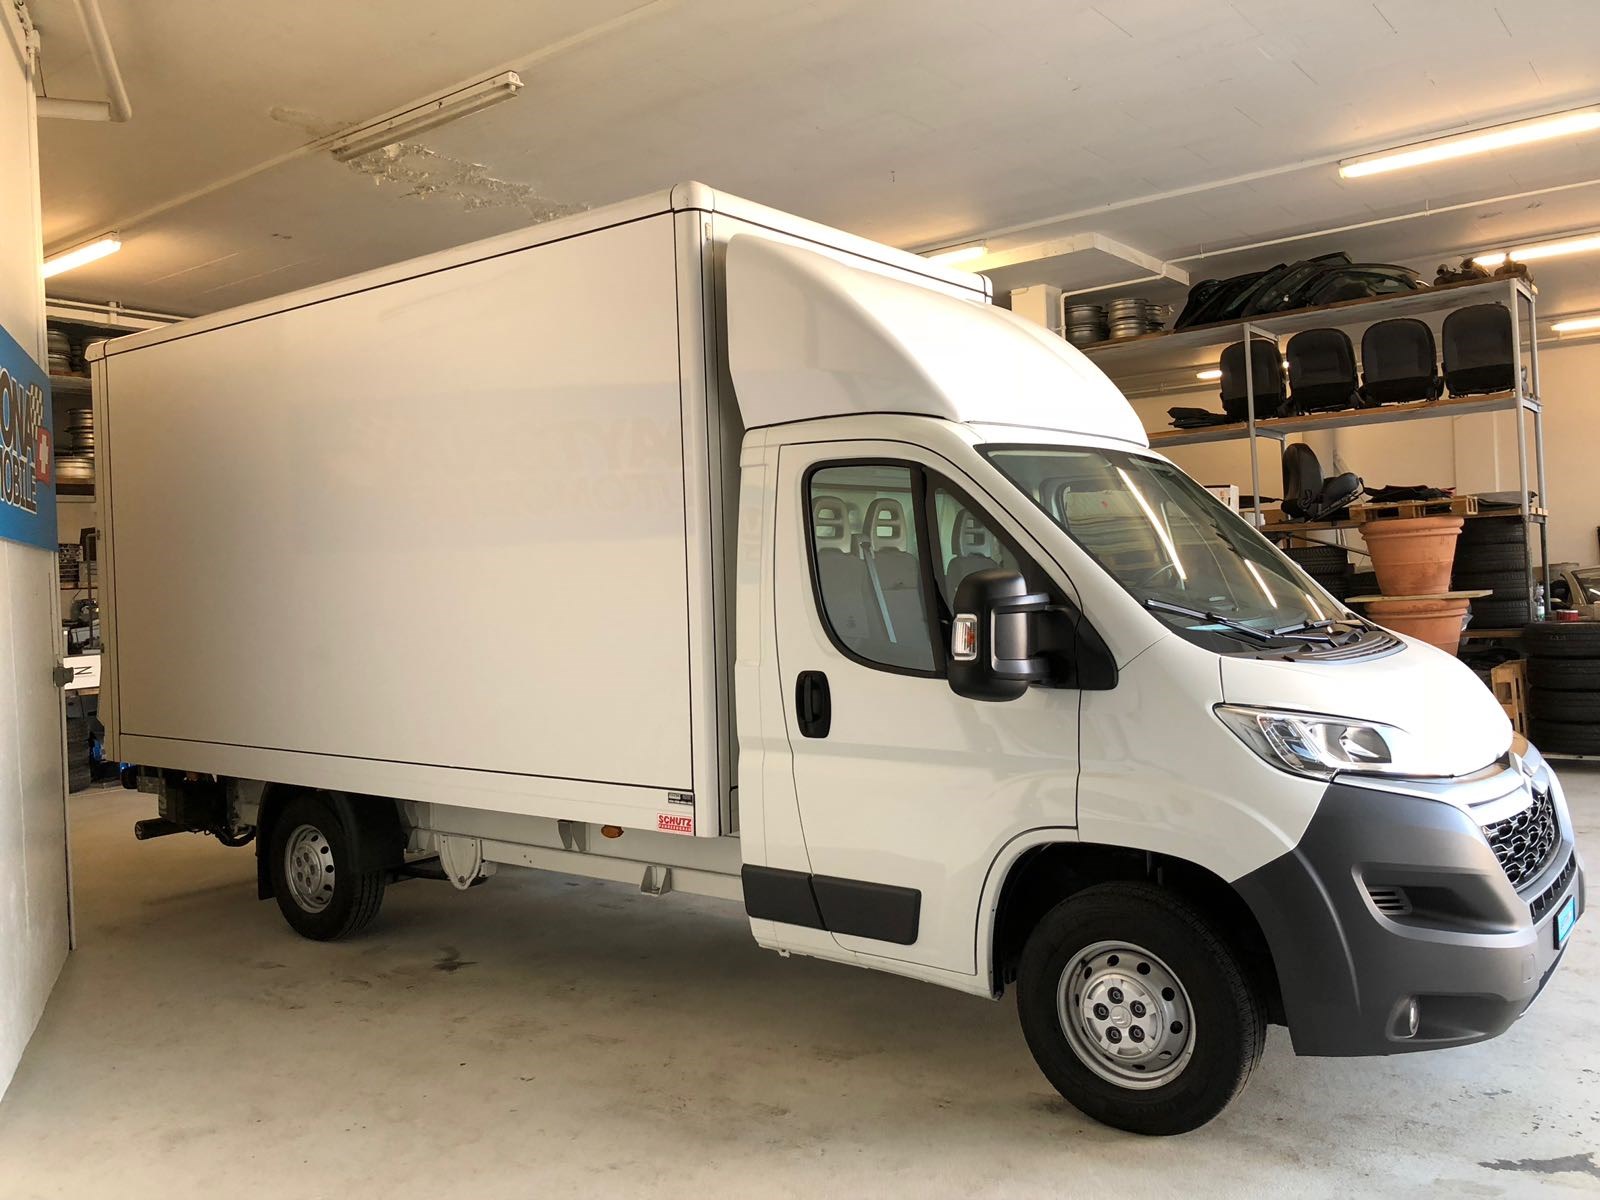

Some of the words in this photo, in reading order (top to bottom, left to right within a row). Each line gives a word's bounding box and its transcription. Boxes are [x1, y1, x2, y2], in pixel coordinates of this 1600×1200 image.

[0, 367, 36, 467] ONA
[0, 447, 37, 514] OBILE
[658, 815, 692, 826] SCHUTZ
